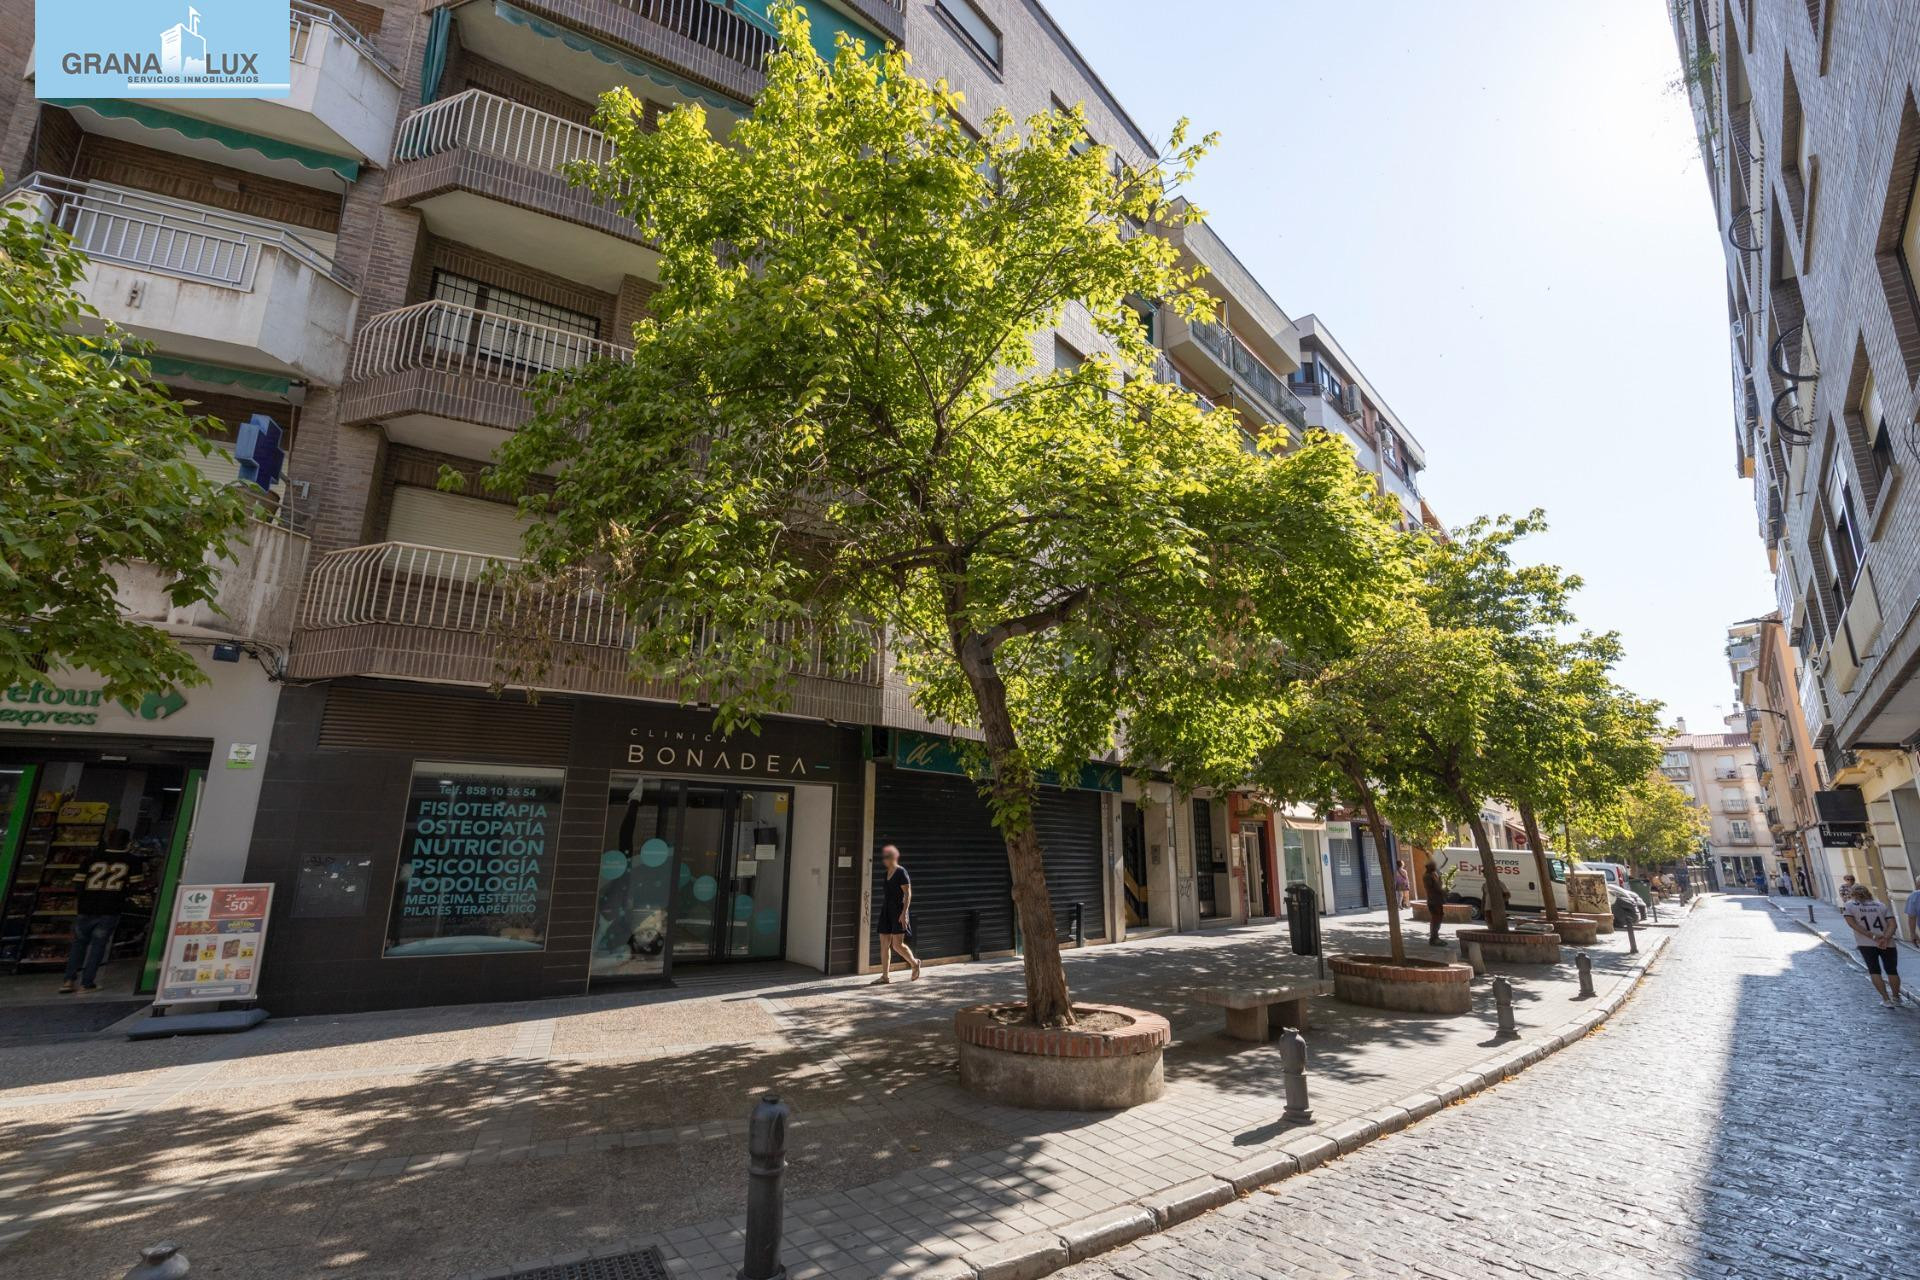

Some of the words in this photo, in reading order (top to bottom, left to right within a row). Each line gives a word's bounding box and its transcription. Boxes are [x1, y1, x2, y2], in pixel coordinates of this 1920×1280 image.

[0, 708, 98, 726] express
[630, 728, 727, 743] CLINICA
[627, 744, 806, 774] BONADEA
[466, 786, 487, 795] 858
[490, 787, 503, 796] 10
[507, 788, 520, 797] 36
[522, 788, 536, 797] 54
[419, 801, 547, 818] FISIOTERAPIA
[417, 818, 545, 836] OSTEOPATÍA
[413, 836, 545, 856] NUTRICIÓN
[410, 856, 541, 875] PSICOLOGÍA
[1459, 861, 1520, 876] Expess
[85, 861, 130, 891] 22
[407, 873, 538, 893] PODOLOGÍA
[405, 894, 474, 905] MEDICINA
[478, 892, 537, 903] ESTÉTICA
[403, 905, 452, 916] PILATES
[455, 903, 537, 915] TERAPÉUTICO
[1861, 915, 1884, 932] 14
